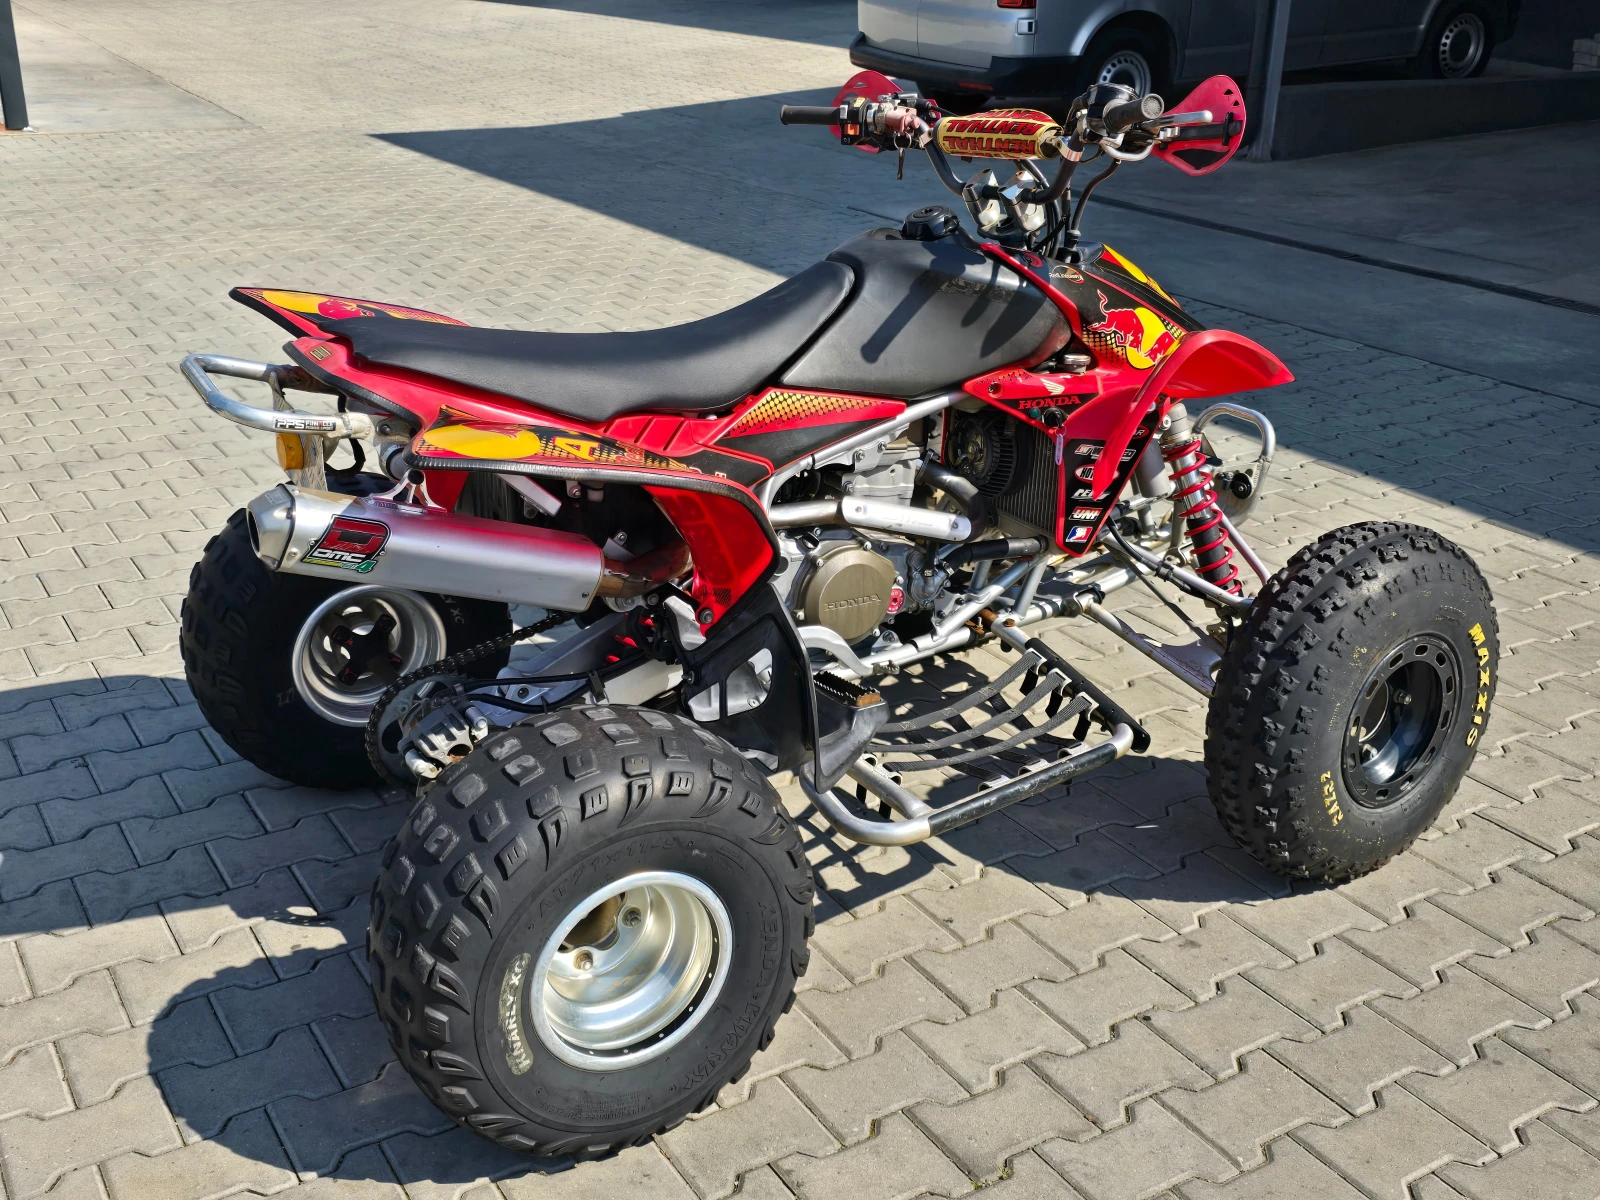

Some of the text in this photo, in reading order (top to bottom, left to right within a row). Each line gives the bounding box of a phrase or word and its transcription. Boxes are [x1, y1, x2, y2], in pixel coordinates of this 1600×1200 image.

[946, 119, 1046, 136] RENTHAL
[943, 136, 1037, 155] RENTHAL
[1018, 395, 1081, 410] HONDA
[277, 419, 305, 429] PPS
[312, 548, 366, 563] DMC
[825, 593, 882, 612] HONDA
[1466, 622, 1490, 748] MAXXIS
